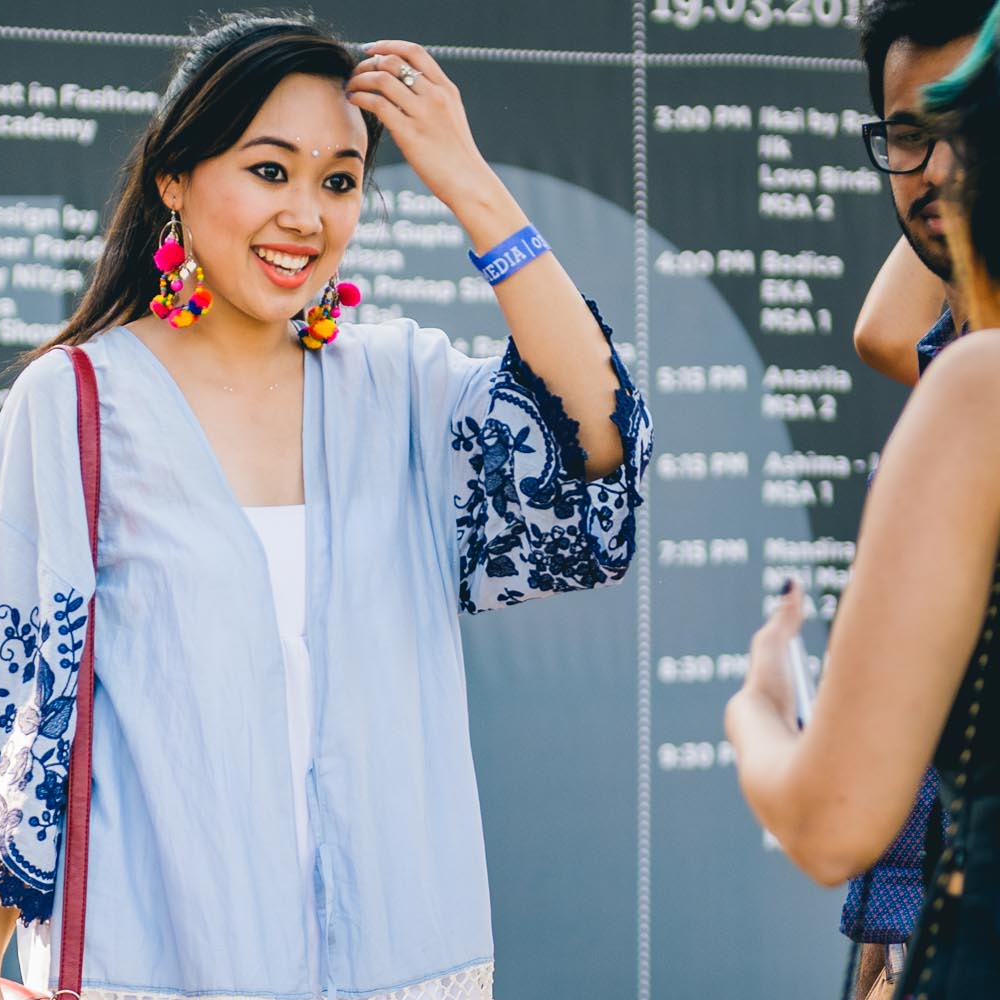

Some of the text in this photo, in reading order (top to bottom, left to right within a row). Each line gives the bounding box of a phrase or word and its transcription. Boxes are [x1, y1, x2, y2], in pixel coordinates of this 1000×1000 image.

[28, 82, 56, 109] in
[60, 84, 159, 112] Fashion
[714, 105, 752, 132] PM
[62, 203, 99, 235] by
[759, 193, 835, 222] MSA 2
[717, 250, 756, 277] PM
[760, 308, 833, 335] MSA 1
[709, 365, 748, 394] PM
[762, 394, 838, 423] MSA 2
[710, 451, 749, 480] PM
[762, 479, 835, 507] MSA 1
[710, 539, 749, 567] PM
